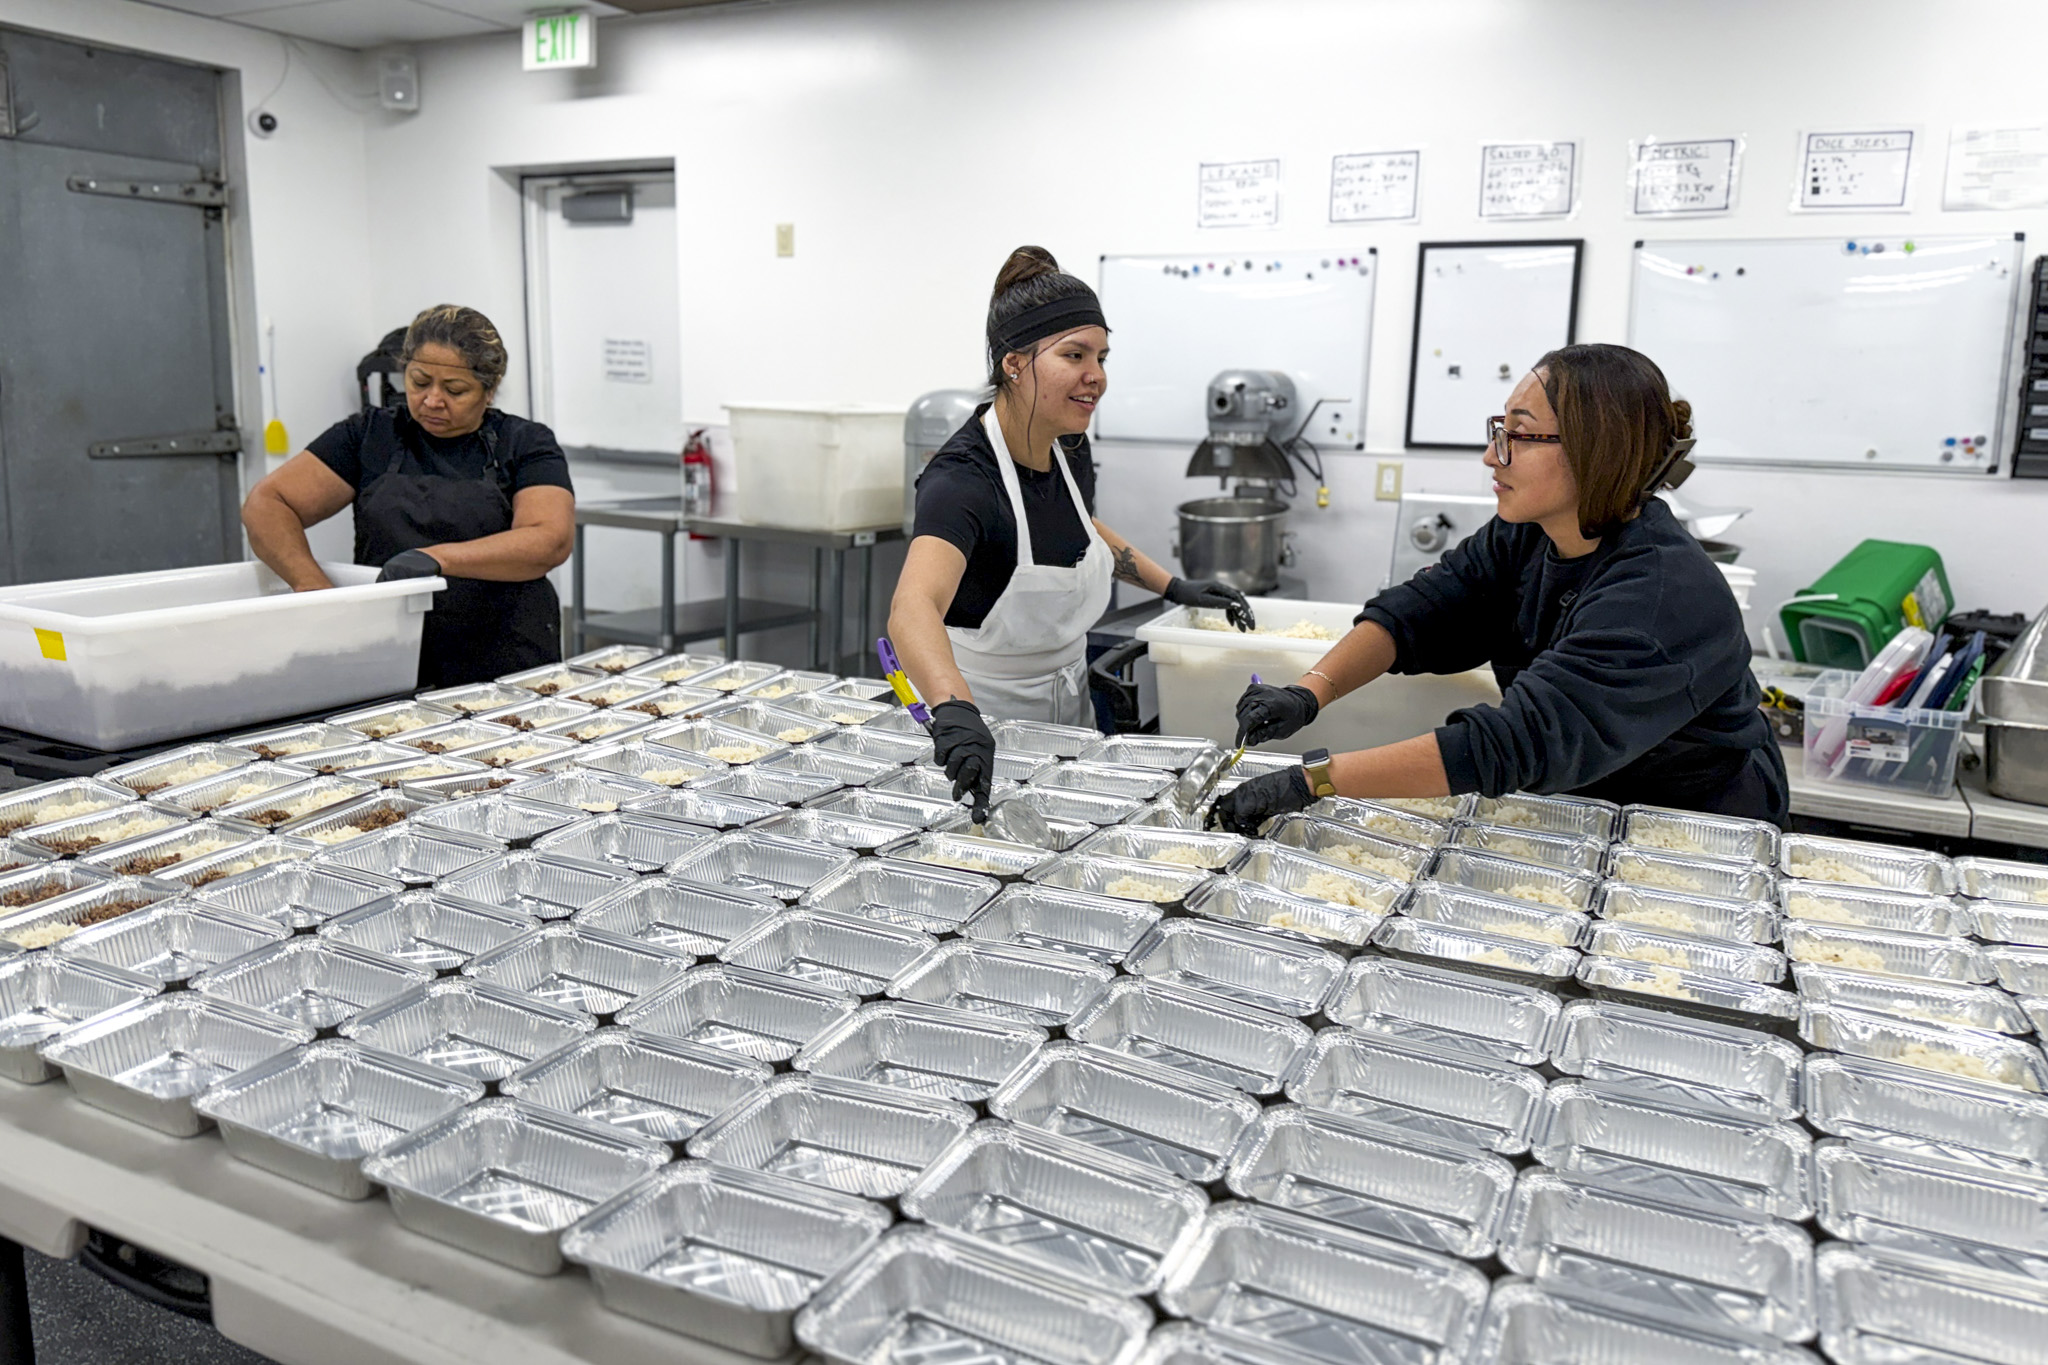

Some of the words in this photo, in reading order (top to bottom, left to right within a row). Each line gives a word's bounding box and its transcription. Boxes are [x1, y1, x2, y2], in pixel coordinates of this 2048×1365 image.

[535, 14, 580, 63] EXIT
[1815, 138, 1845, 149] DICE
[1489, 148, 1531, 160] SALTED
